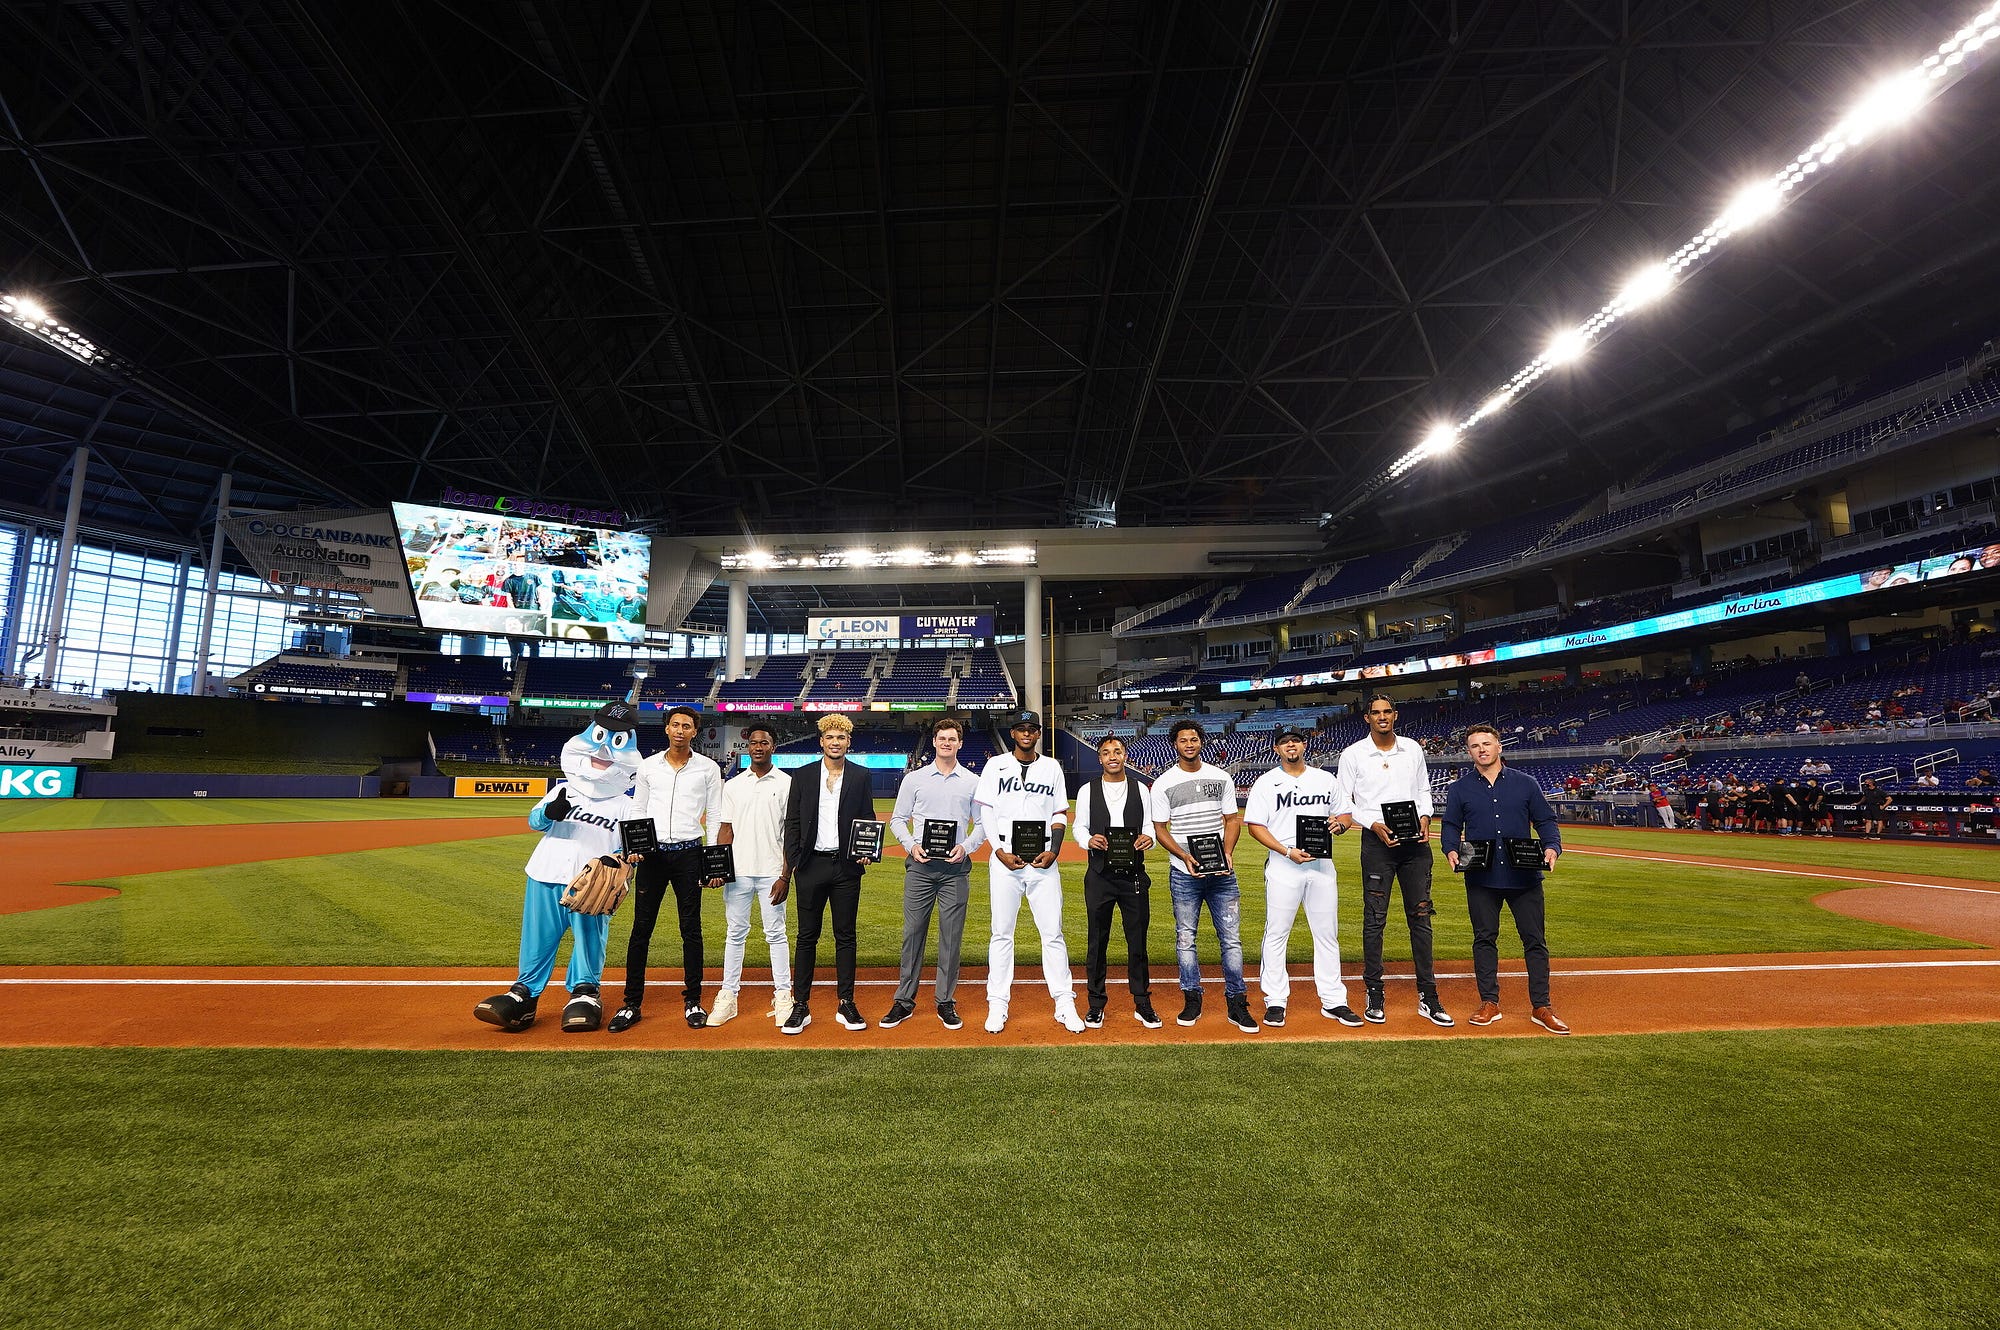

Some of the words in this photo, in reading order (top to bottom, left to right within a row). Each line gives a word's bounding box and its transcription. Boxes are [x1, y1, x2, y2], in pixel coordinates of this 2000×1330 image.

[442, 486, 569, 518] loanDepot
[572, 504, 625, 527] park
[271, 542, 370, 567] AutoNation
[370, 578, 399, 589] MIAMI
[349, 610, 360, 618] 42
[1725, 597, 1781, 617] Marlins
[841, 620, 888, 632] LEON
[917, 617, 976, 627] CUTWATER
[1565, 632, 1607, 648] Marlins
[736, 703, 784, 711] Multinational
[0, 746, 36, 760] Alley
[998, 775, 1055, 797] Miami
[1275, 791, 1332, 812] Miami
